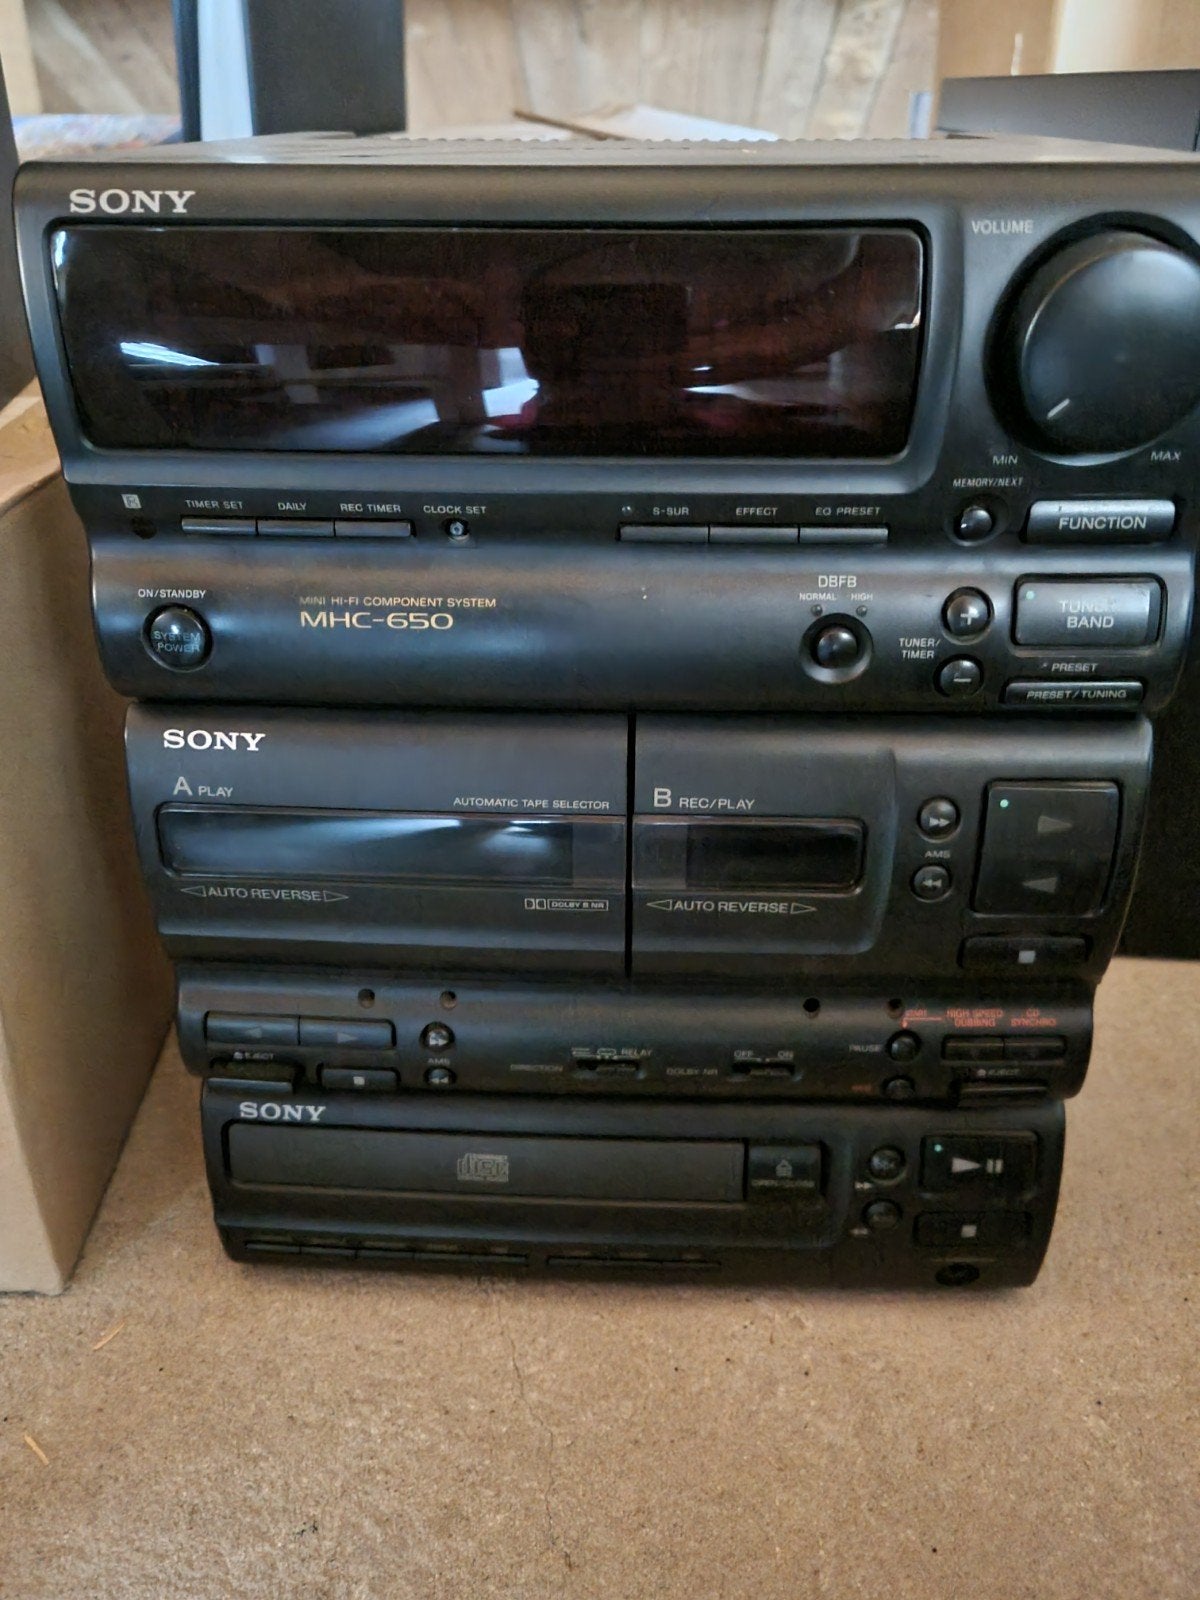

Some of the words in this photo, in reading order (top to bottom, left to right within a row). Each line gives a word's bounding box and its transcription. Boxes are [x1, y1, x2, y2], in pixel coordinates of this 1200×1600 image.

[69, 189, 196, 214] SONY
[971, 219, 1034, 234] VOLUME
[992, 455, 1018, 466] MIN
[1150, 451, 1182, 462] MAX
[952, 477, 1024, 488] MEMORY/NEXT
[185, 499, 219, 509] TIMER
[223, 500, 244, 510] SET
[277, 501, 308, 511] DAILY
[340, 503, 363, 513] REC
[368, 504, 401, 514] TIMER
[423, 505, 461, 515] CLOCK
[465, 506, 487, 515] SET
[735, 507, 779, 517] EFFECT
[815, 507, 833, 517] EQ
[836, 507, 881, 517] PRESET
[1058, 516, 1148, 531] FUNCTION
[818, 575, 858, 588] DBFB
[138, 588, 207, 600] ON/STANDBY
[799, 592, 837, 601] NORMAL
[850, 593, 874, 601] HIGH
[300, 596, 327, 607] MINI
[331, 597, 359, 607] HI-FI
[363, 597, 443, 608] COMPONENT
[446, 598, 497, 609] SYSTEM
[300, 611, 454, 630] MHC-650
[1066, 616, 1115, 629] BAND
[153, 630, 201, 643] SYSTEM
[157, 641, 201, 653] POWER
[899, 637, 941, 649] TUNER/
[902, 650, 935, 660] TIMER
[1051, 662, 1098, 673] PRESET
[162, 728, 266, 752] SONY
[173, 776, 193, 796] A
[198, 785, 234, 797] PLAY
[453, 797, 519, 808] AUTOMATIC
[523, 799, 549, 808] TAPE
[552, 799, 610, 809] SELECTOR
[653, 787, 672, 808] B
[679, 797, 756, 810] REC/PLAY
[924, 850, 950, 859] AMS
[207, 886, 249, 898] AUTO
[251, 888, 322, 901] REVERSE
[551, 901, 580, 909] DOLBY
[673, 900, 716, 912] AUTO
[717, 901, 789, 914] REVERSE
[239, 1101, 326, 1122] SONY
